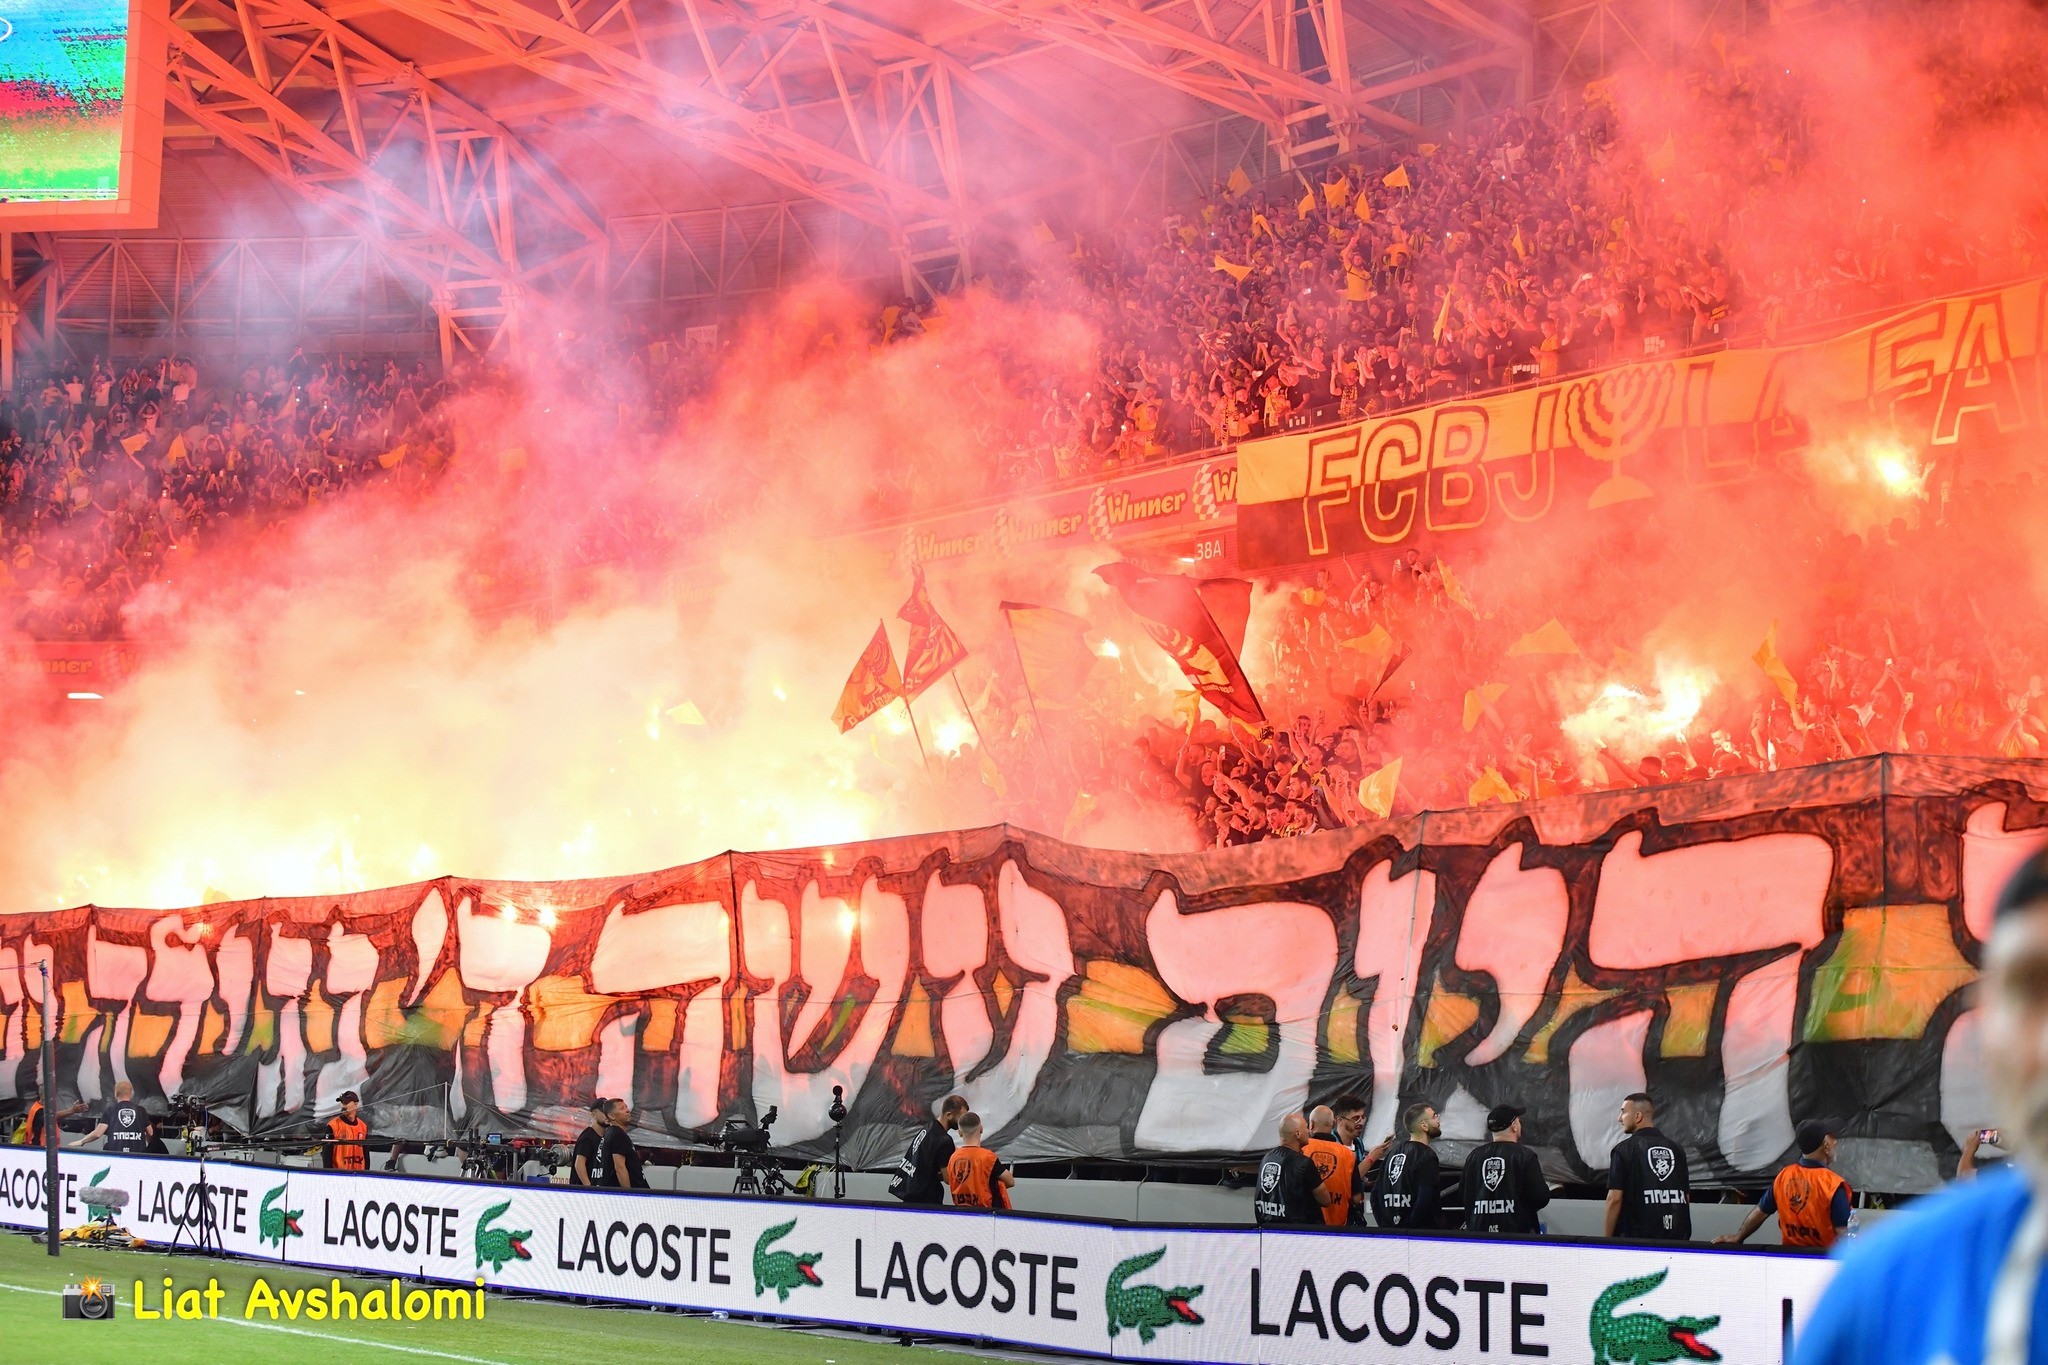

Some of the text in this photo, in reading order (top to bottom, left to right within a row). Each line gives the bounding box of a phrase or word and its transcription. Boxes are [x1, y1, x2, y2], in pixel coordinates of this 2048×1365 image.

[1303, 387, 1561, 555] FCBJ
[1867, 280, 2048, 445] FA
[915, 532, 984, 561] Winner
[1107, 492, 1187, 523] Winner
[1196, 540, 1222, 561] 38A
[113, 1131, 142, 1140] אבטחה
[1473, 1199, 1515, 1215] אבטחה
[1643, 1189, 1687, 1204] אבטחה
[138, 1180, 248, 1234] LACOSTE
[323, 1198, 459, 1257] LACOSTE
[557, 1218, 731, 1284] LACOSTE
[855, 1238, 1078, 1321] LACOSTE
[1250, 1268, 1549, 1357] LACOSTE
